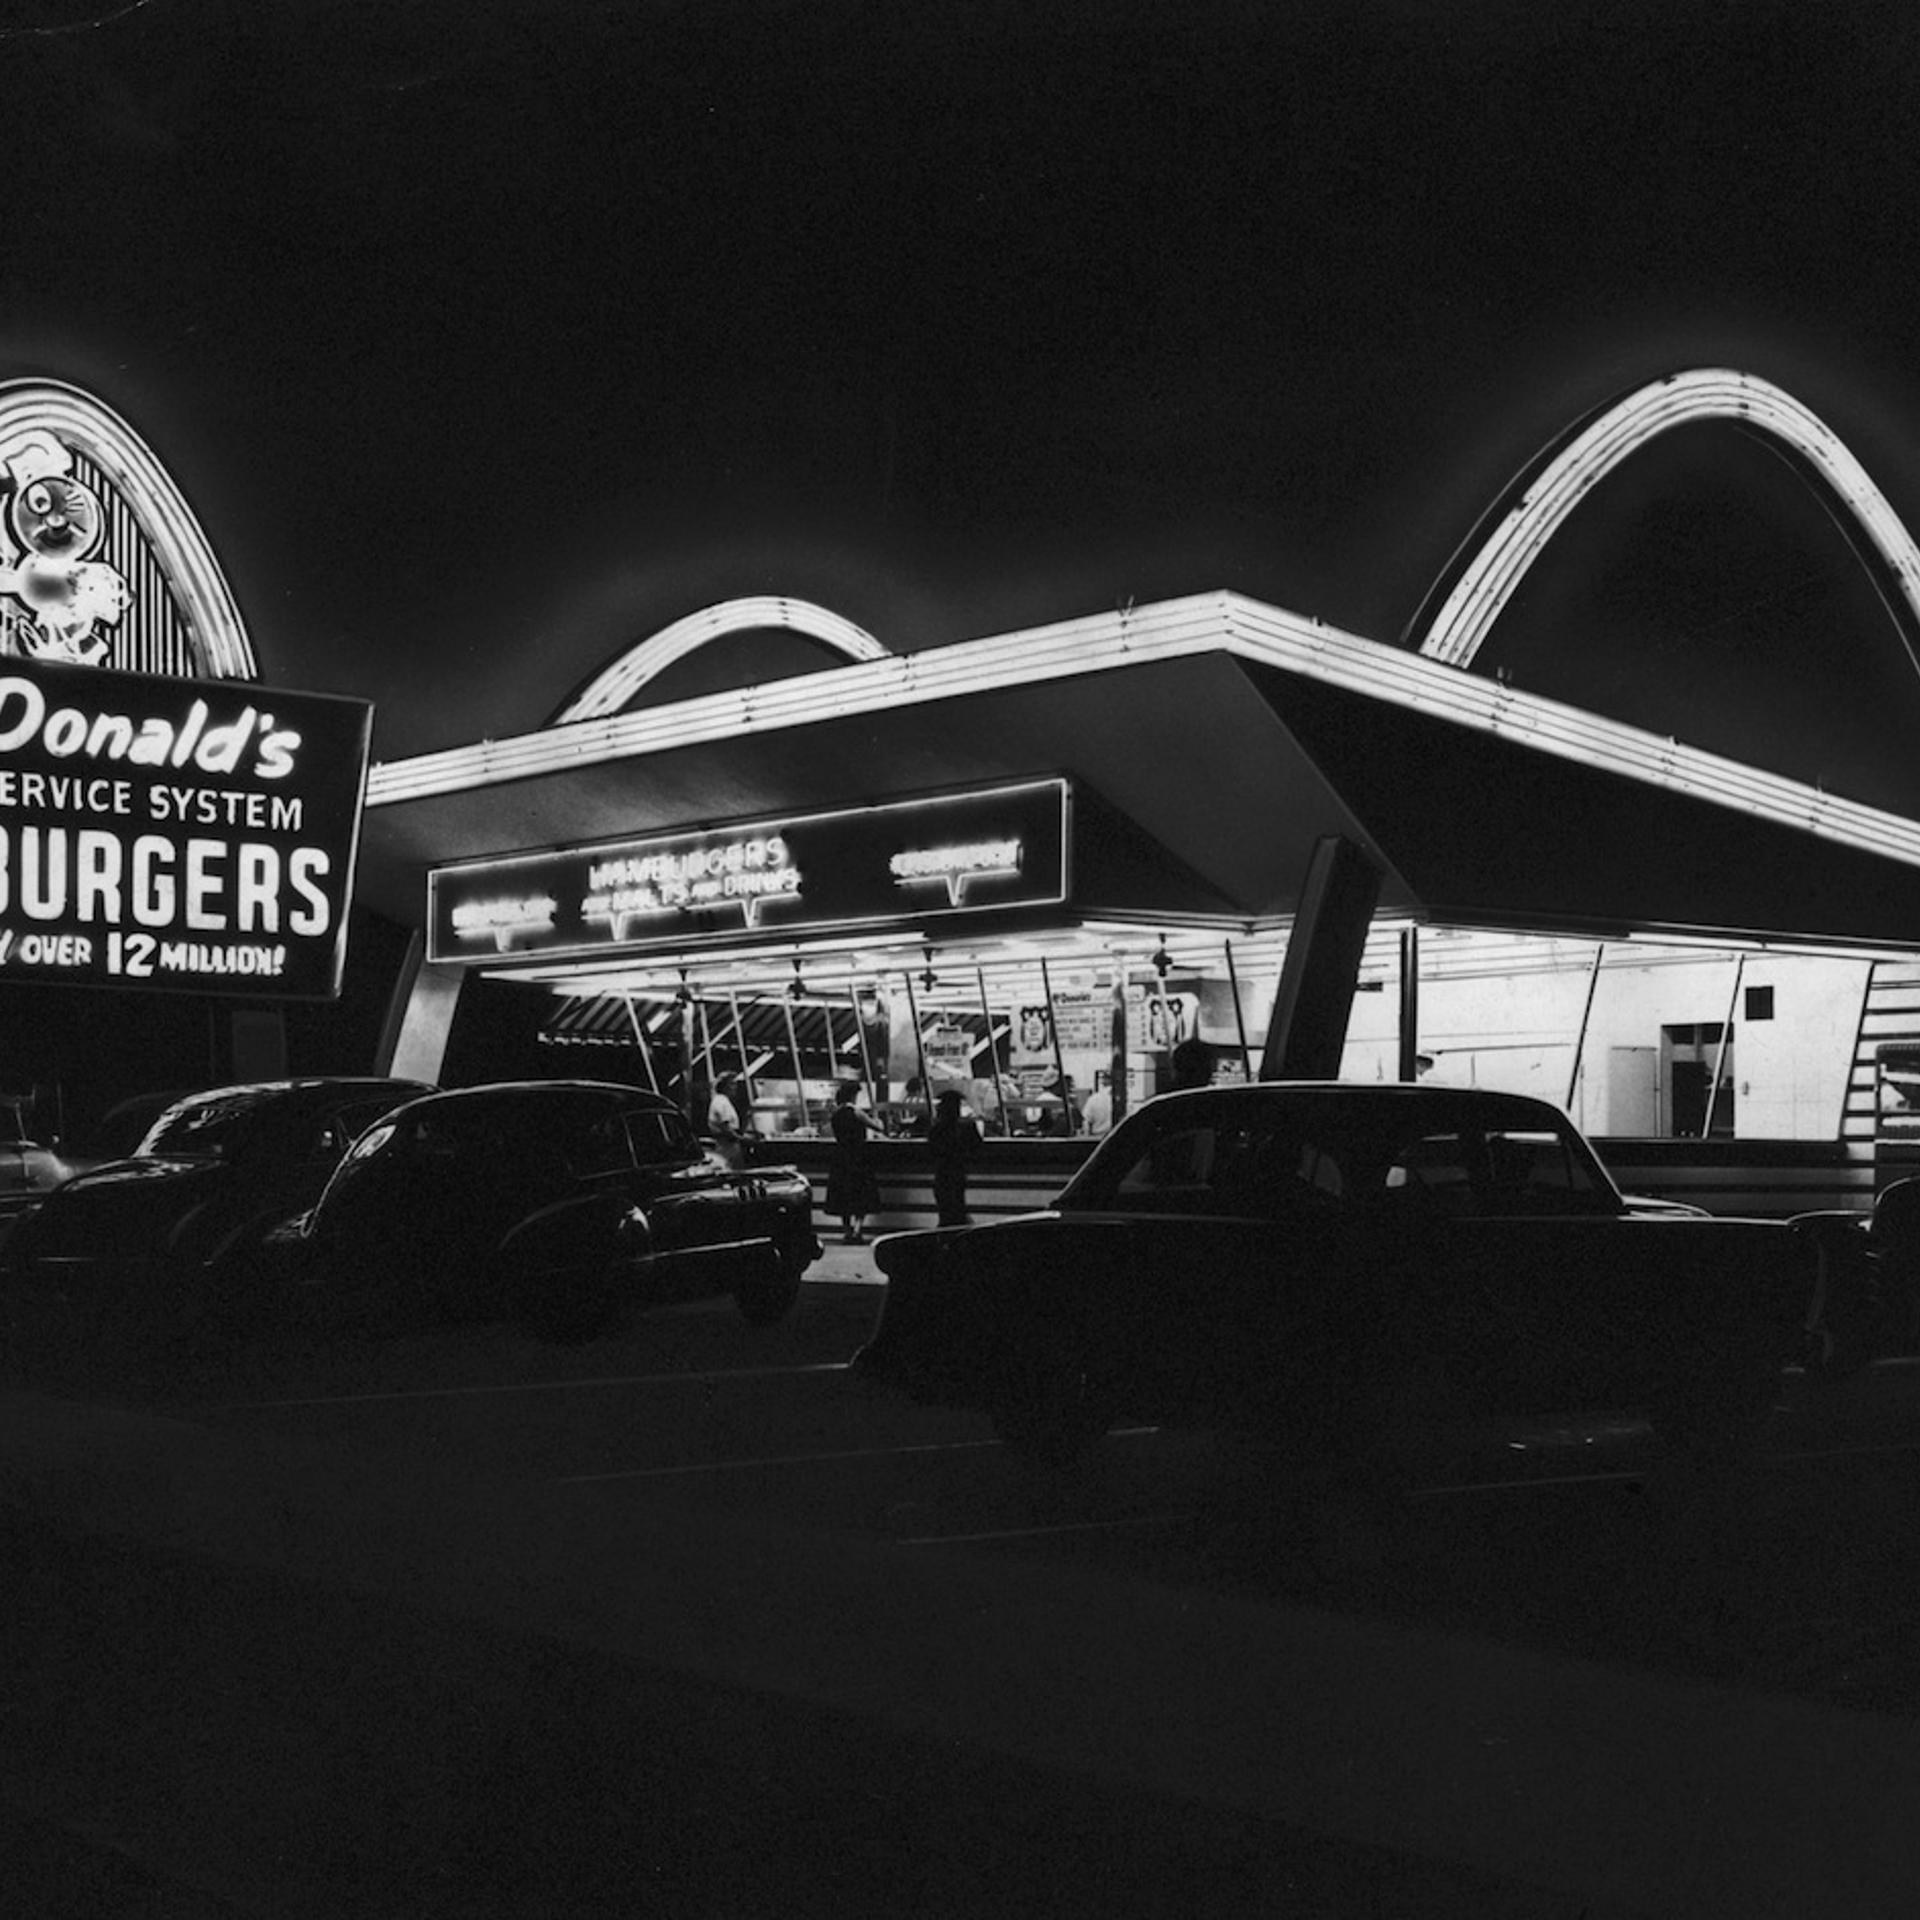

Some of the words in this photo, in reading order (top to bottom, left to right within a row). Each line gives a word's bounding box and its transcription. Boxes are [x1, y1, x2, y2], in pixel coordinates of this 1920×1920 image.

[149, 785, 303, 833] SYSTEM
[0, 824, 331, 938] URGERS
[20, 934, 93, 967] OVER
[107, 931, 157, 977] 12
[160, 939, 287, 976] MILLION!
